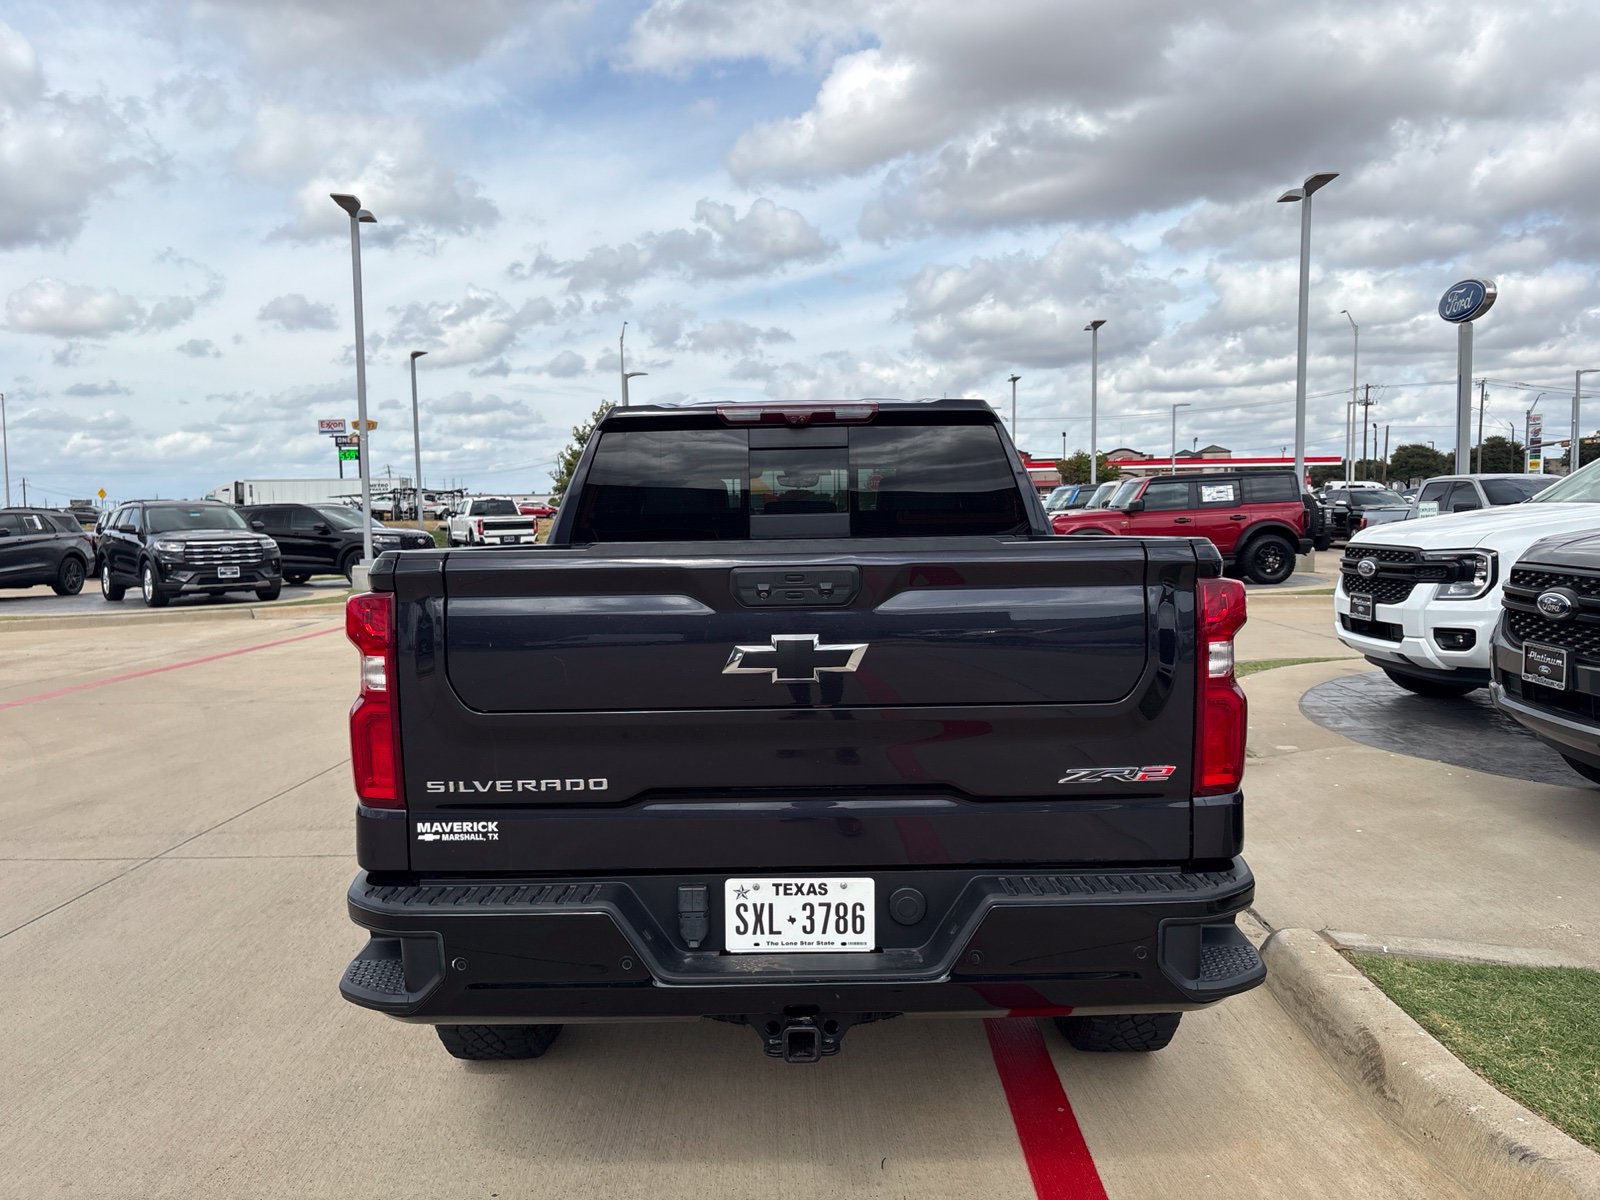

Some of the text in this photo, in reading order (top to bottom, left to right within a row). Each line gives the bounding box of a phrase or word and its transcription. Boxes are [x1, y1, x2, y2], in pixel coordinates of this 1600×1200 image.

[1445, 287, 1474, 315] Ford
[320, 420, 343, 430] Exxon
[1542, 597, 1562, 613] Ford
[1527, 650, 1564, 667] Platinum
[1058, 765, 1176, 783] ZR2
[426, 778, 608, 793] SILVERADO
[416, 821, 499, 833] MAVERICK
[441, 833, 499, 841] MARSHALL, TX
[772, 882, 828, 896] TEXAS
[735, 902, 865, 935] SXL 3786
